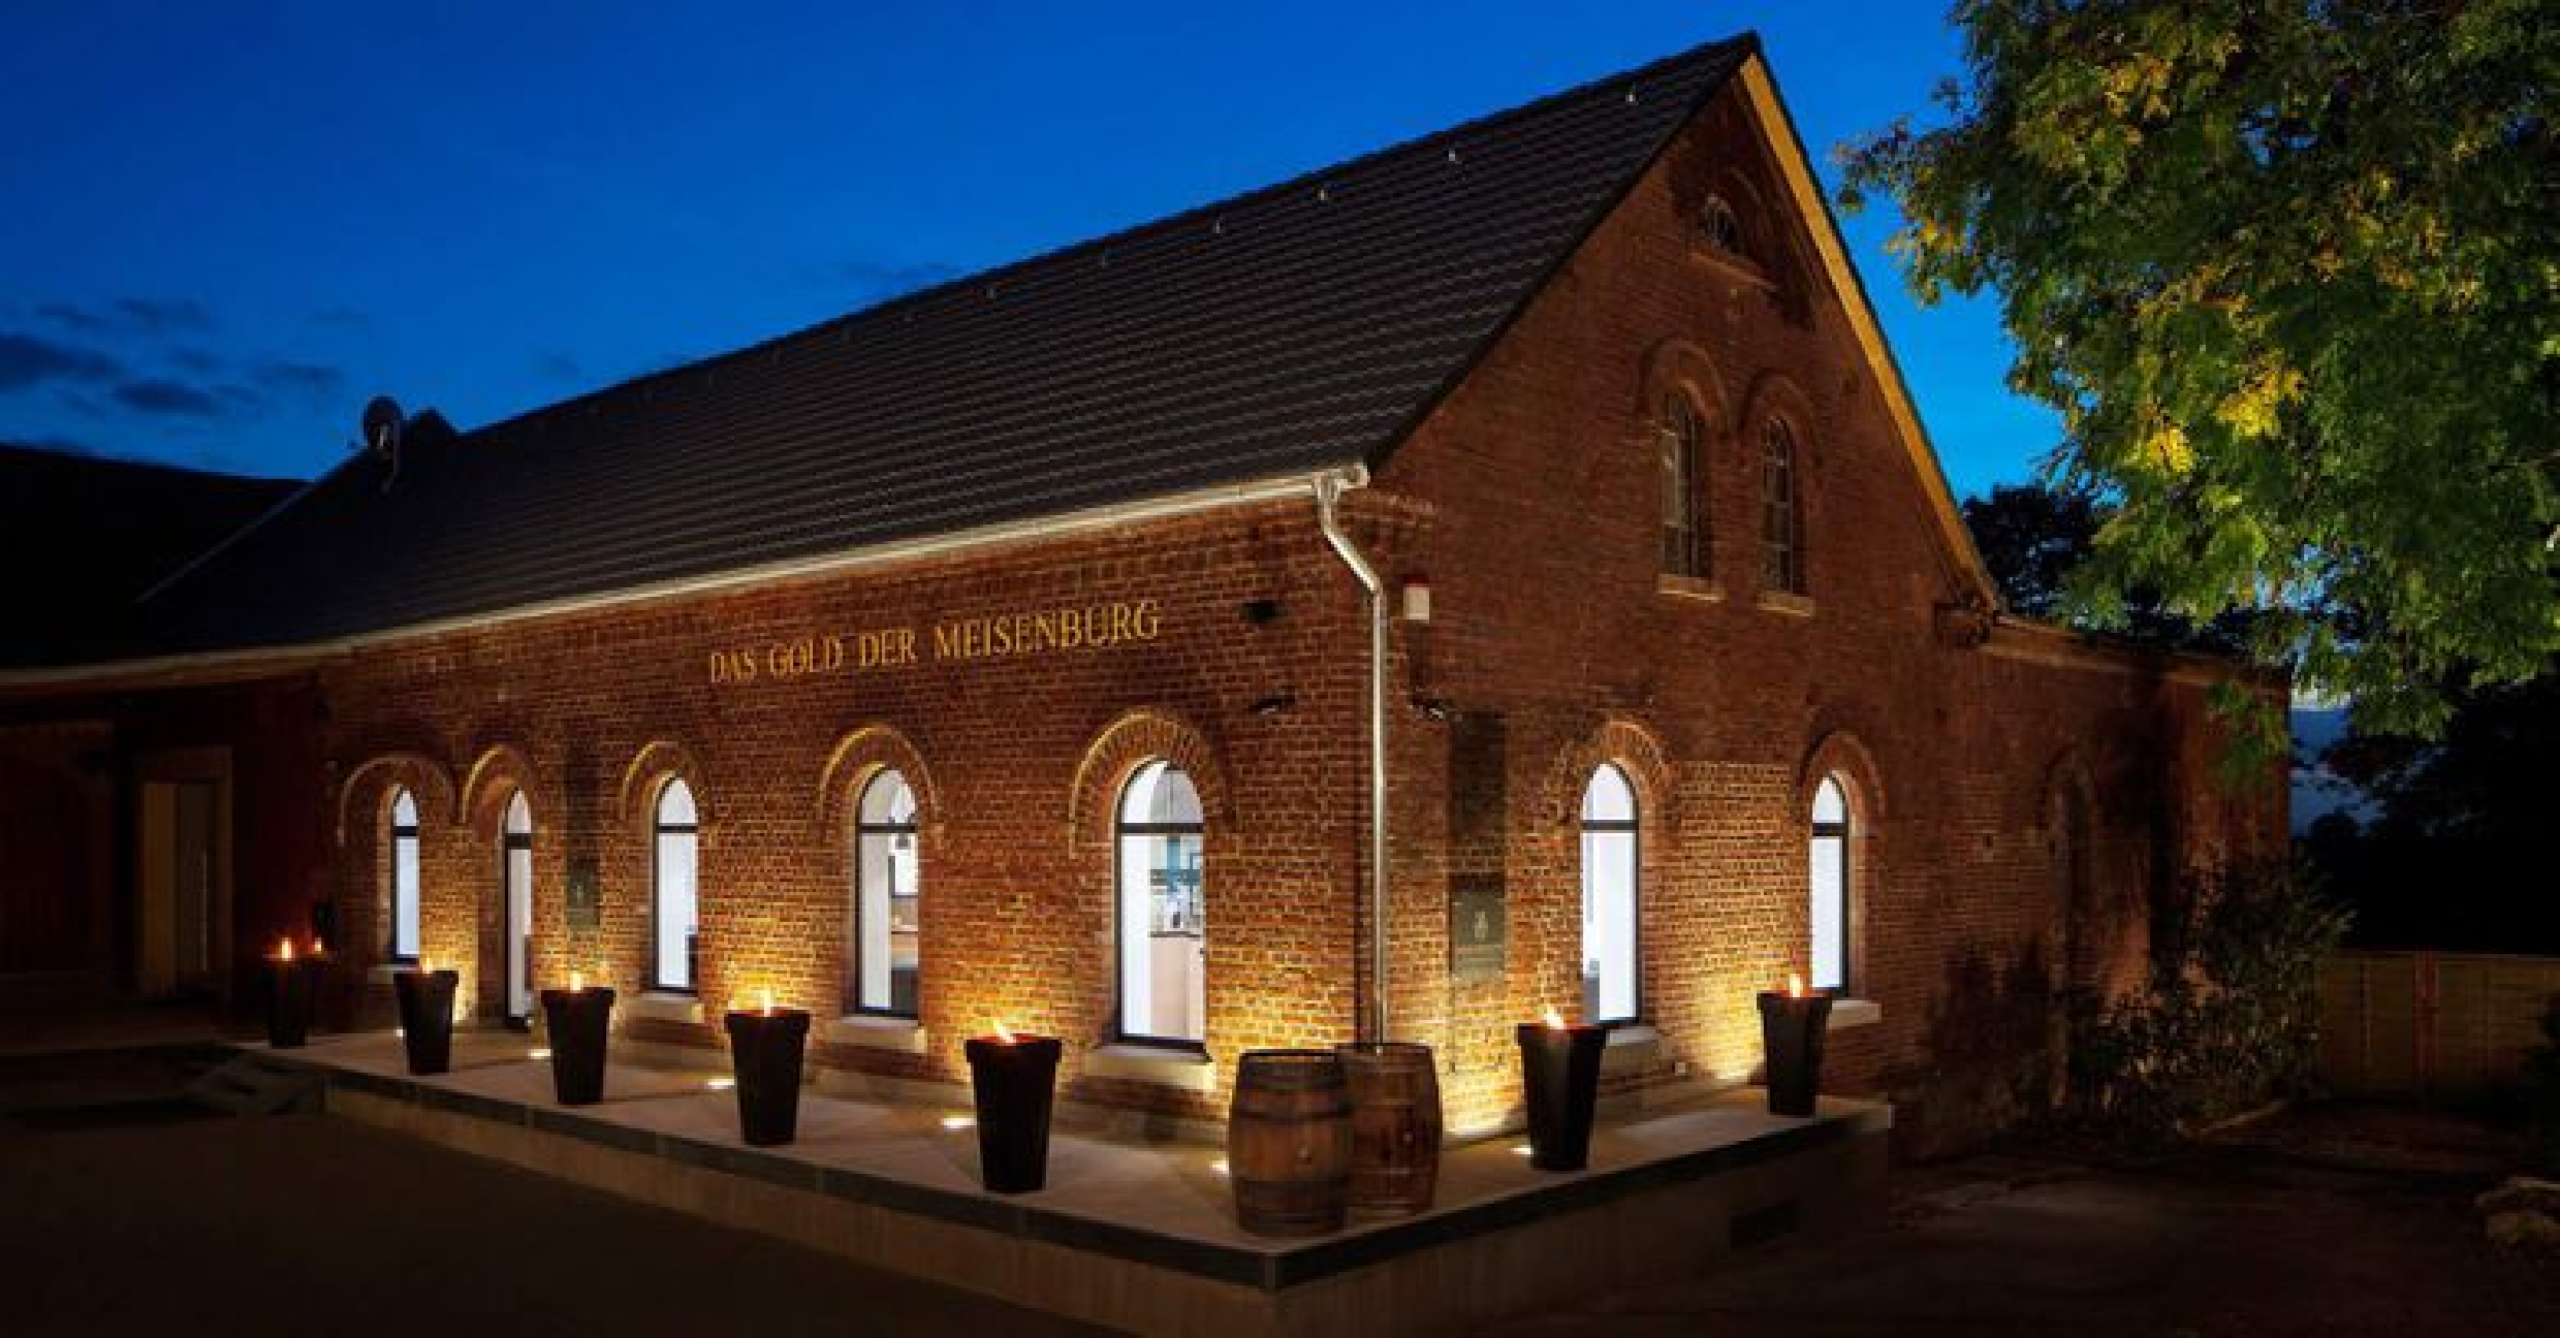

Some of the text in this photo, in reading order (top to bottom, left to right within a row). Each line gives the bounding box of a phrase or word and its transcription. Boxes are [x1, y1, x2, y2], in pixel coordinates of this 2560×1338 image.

[710, 600, 1160, 683] DAS GOLD DER MEISENBURG
